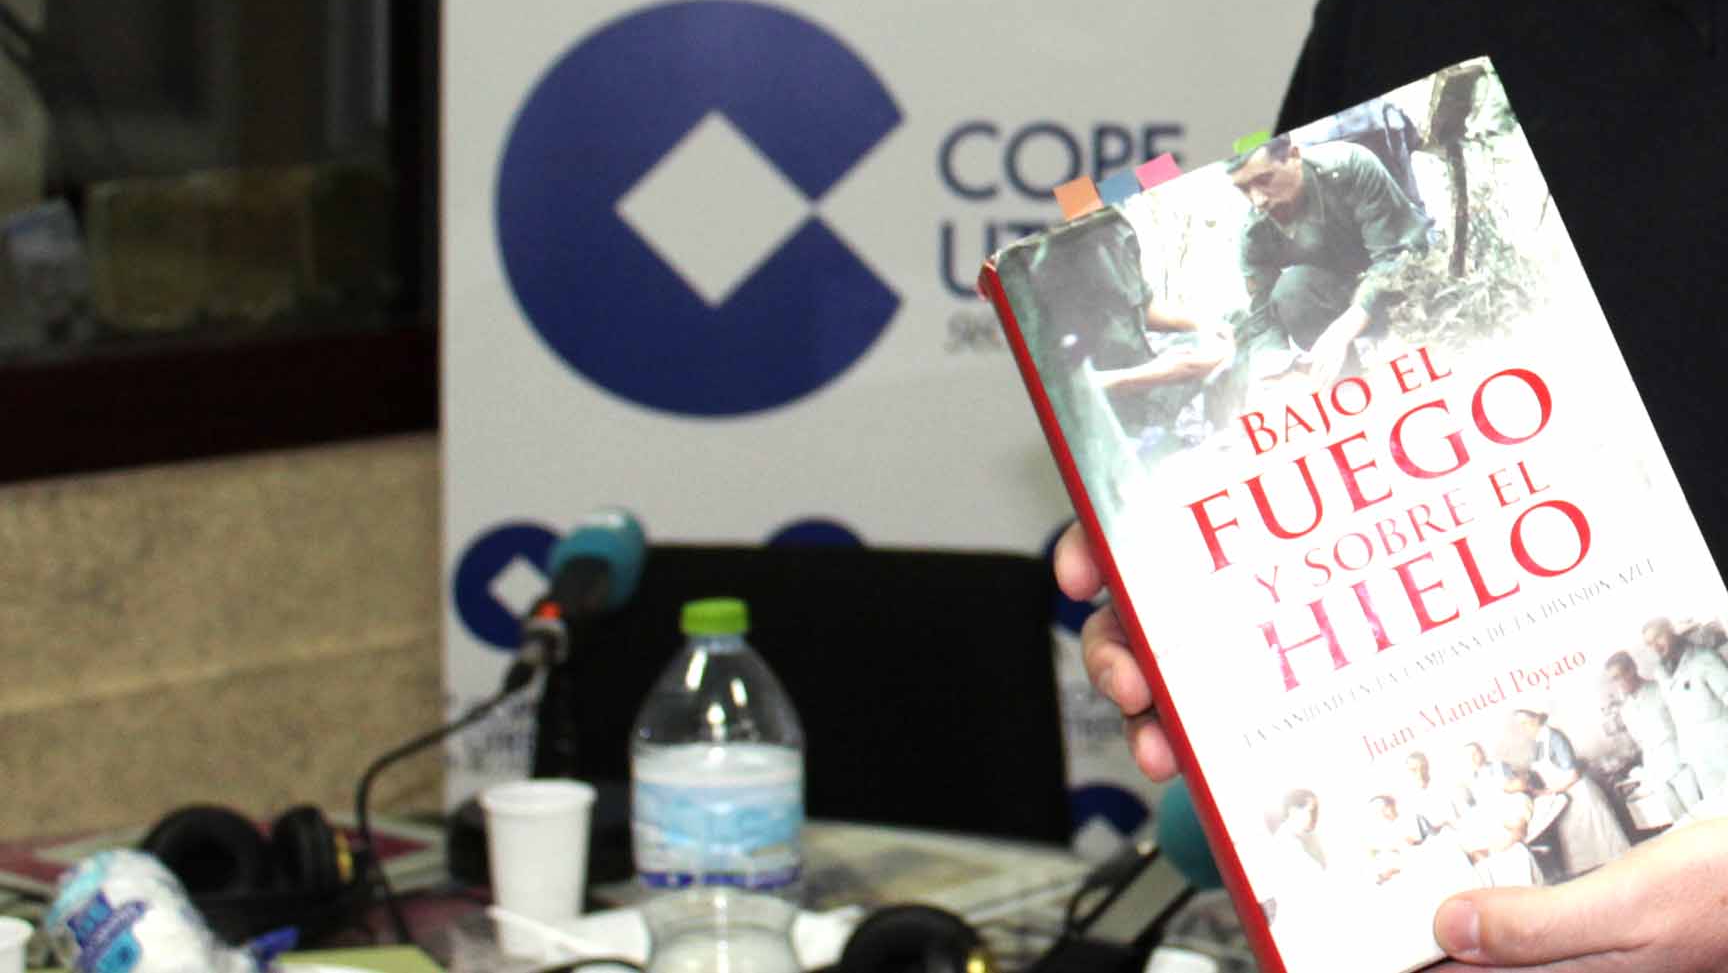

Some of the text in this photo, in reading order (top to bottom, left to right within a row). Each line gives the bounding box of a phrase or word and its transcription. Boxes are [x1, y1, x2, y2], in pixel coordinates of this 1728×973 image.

[1184, 368, 1553, 572] FUEGO
[1237, 347, 1453, 456] BAJO EL
[1254, 460, 1551, 605] Y SOBRE EL
[1257, 500, 1592, 692] HIELO
[1362, 650, 1588, 762] Juan Manuel Poyato
